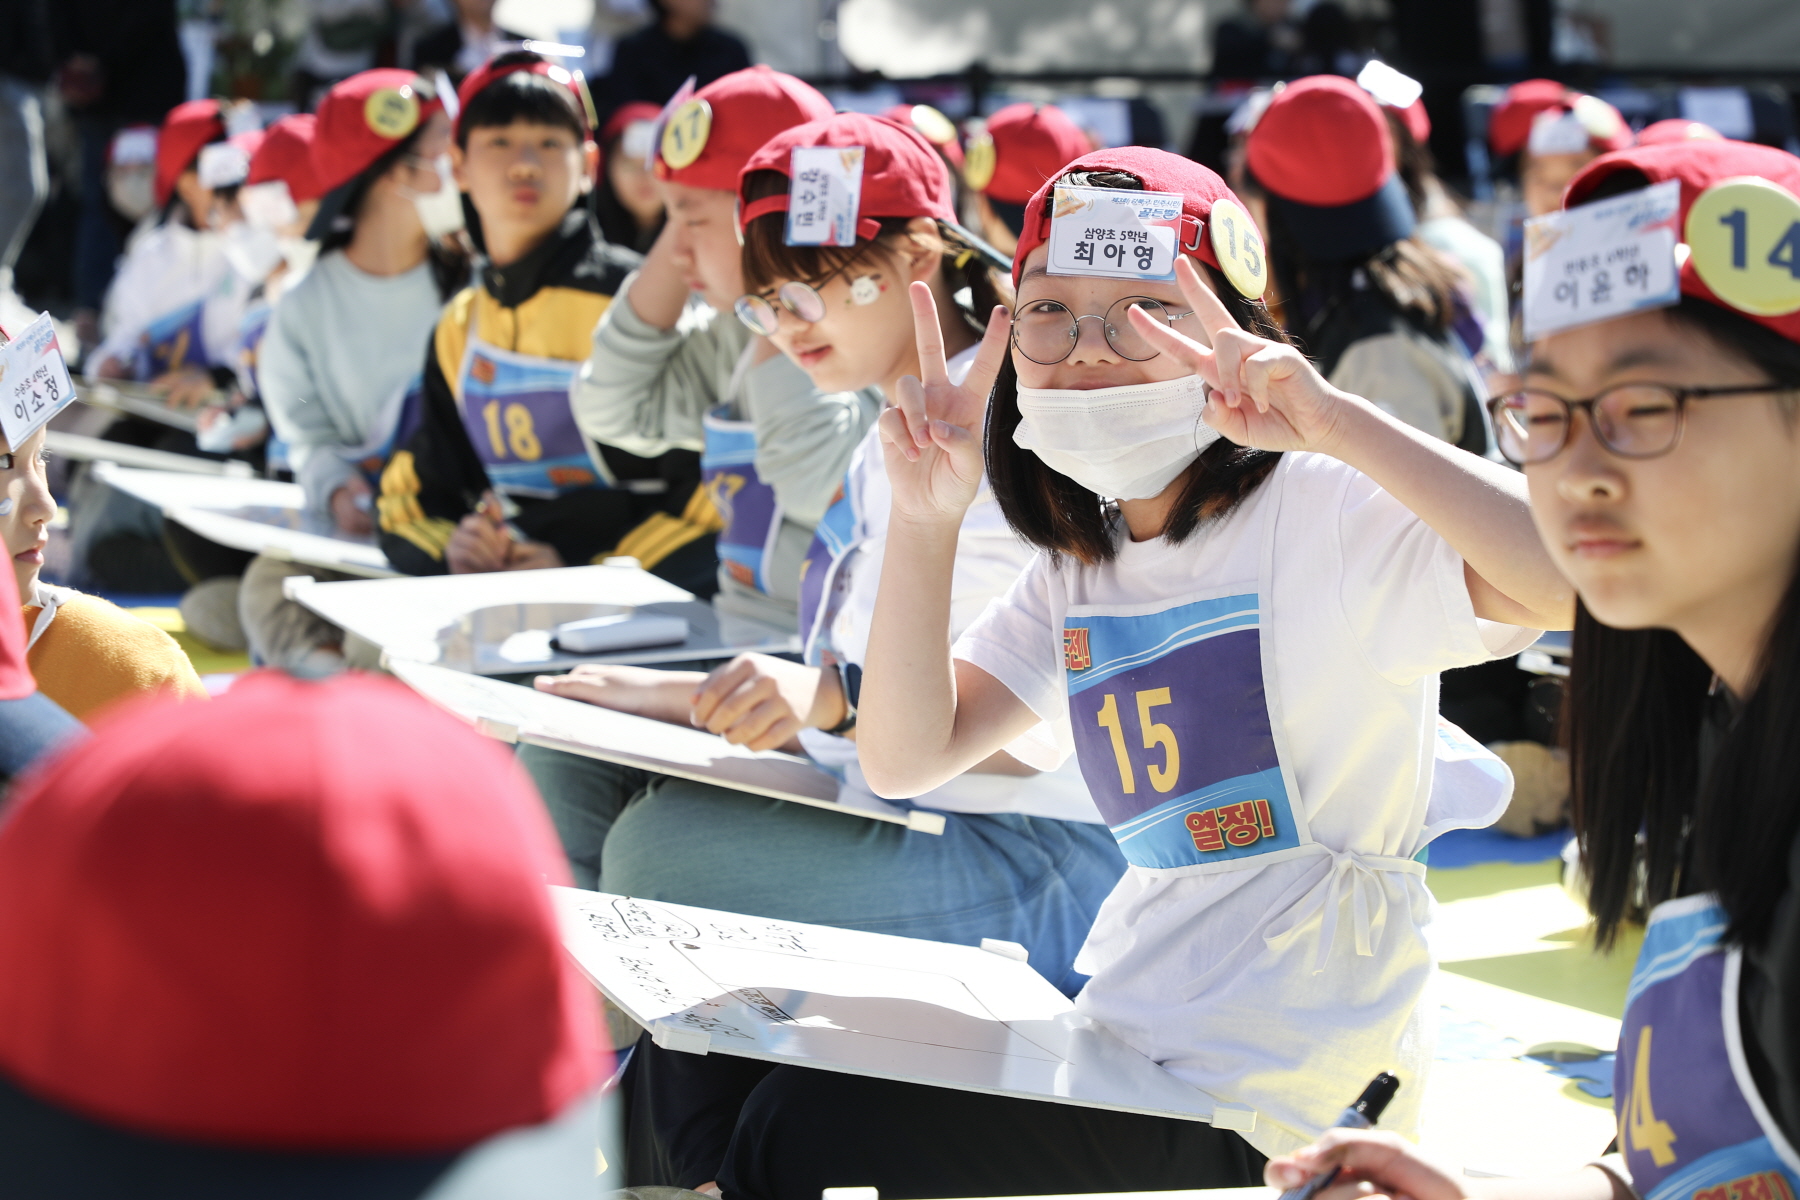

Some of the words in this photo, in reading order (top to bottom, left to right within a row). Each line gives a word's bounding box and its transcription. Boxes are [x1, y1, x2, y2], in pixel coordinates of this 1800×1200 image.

[1084, 227, 1116, 240] 삼양초
[1120, 231, 1148, 243] 5학년
[1222, 216, 1261, 277] 15
[1719, 208, 1800, 280] 14
[482, 399, 543, 462] 18
[1097, 686, 1180, 795] 15
[1184, 799, 1275, 852] 열정!
